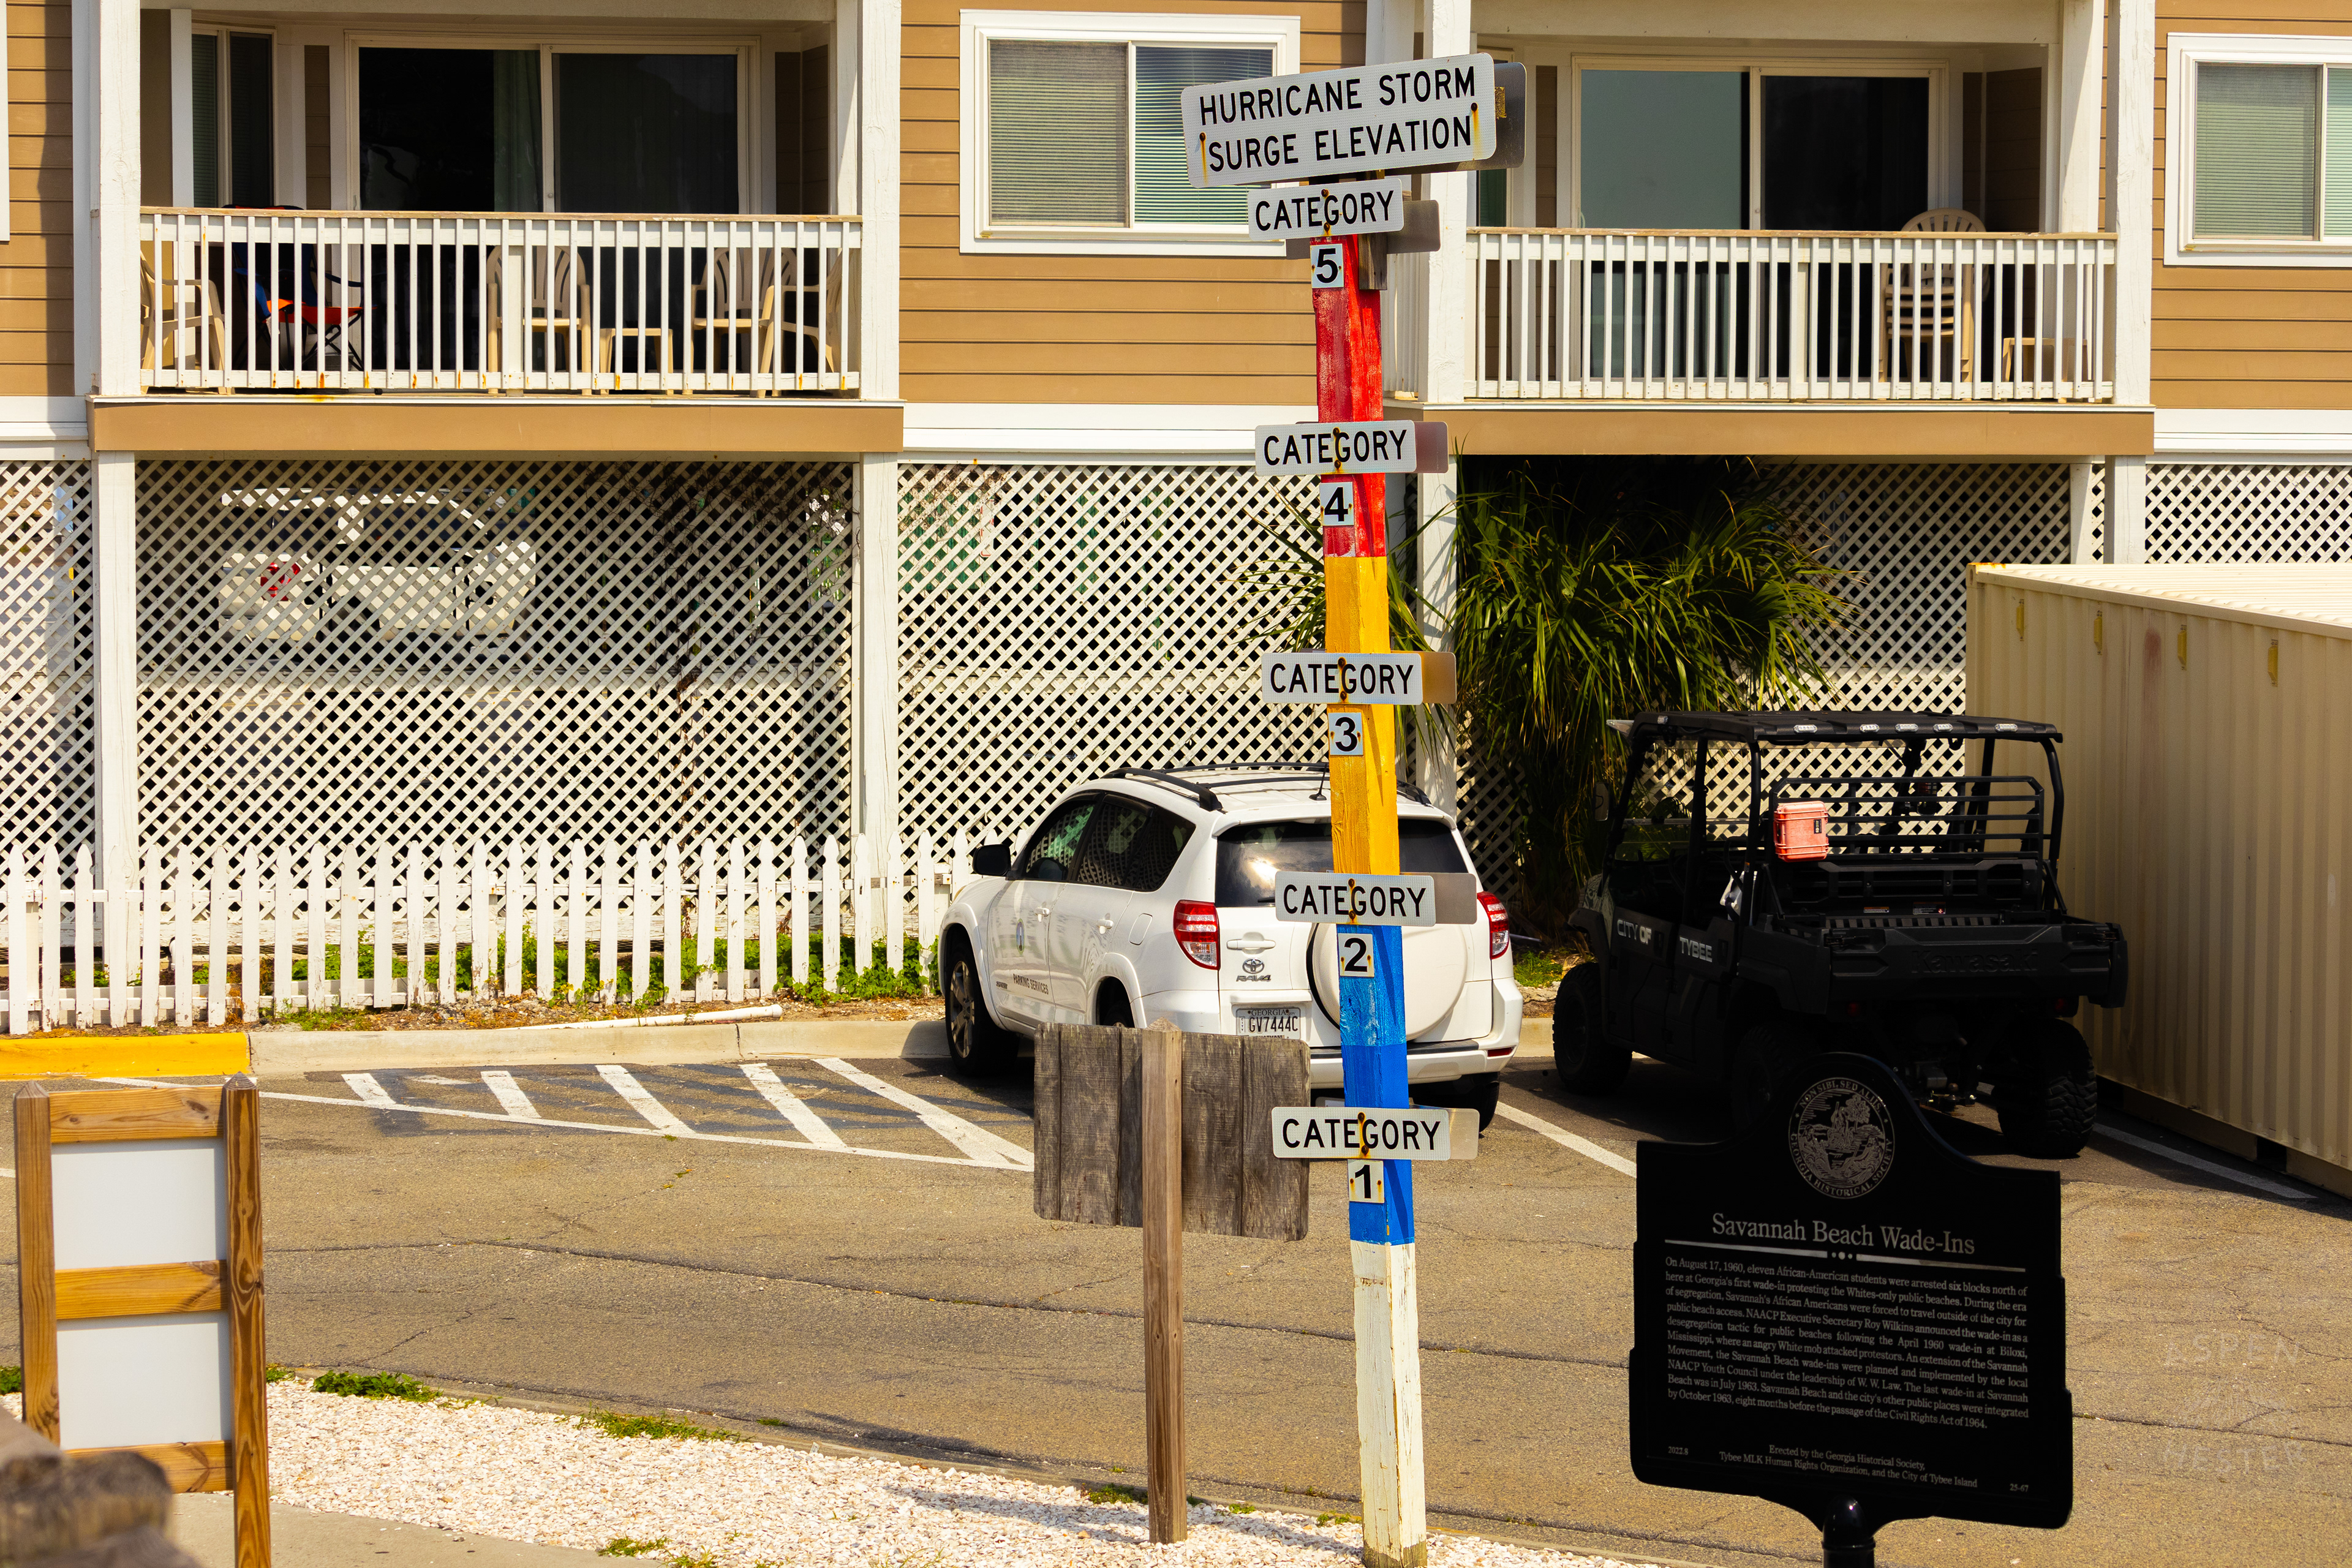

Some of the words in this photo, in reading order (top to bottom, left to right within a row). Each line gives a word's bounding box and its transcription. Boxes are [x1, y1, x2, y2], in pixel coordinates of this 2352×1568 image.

[1199, 78, 1363, 126] HURRICANE
[1379, 66, 1476, 107] STORM
[1208, 134, 1299, 173] SURGE
[1314, 115, 1471, 162] ELEVATION
[1256, 190, 1395, 231] CATEGORY
[1316, 247, 1339, 284] 5
[1264, 429, 1408, 466] CATEGORY
[1324, 487, 1349, 522] 4
[1270, 663, 1414, 695] CATEGORY
[1335, 717, 1359, 753] 3
[1283, 884, 1427, 918] CATEGORY
[1344, 938, 1368, 973] 2
[1616, 919, 1638, 940] CITY
[1639, 926, 1652, 945] OF
[1679, 937, 1713, 962] TYBEE
[1912, 949, 2038, 973] Kawasaki
[1013, 973, 1030, 988] PARKING
[1030, 979, 1049, 995] SERVICES
[1249, 1016, 1298, 1032] GV7444C
[1799, 1089, 1817, 1109] NON
[1840, 1080, 1858, 1091] SED
[1282, 1118, 1441, 1150] CATEGORY
[1354, 1164, 1372, 1199] 1
[1790, 1133, 1813, 1183] GEORGIA
[1814, 1179, 1873, 1197] HISTORICAL
[1873, 1139, 1893, 1183] SOCIETY
[1712, 1213, 1806, 1240] Savannah
[1812, 1220, 1874, 1246] Beach
[1880, 1226, 1974, 1254] Wade-Ins
[1665, 1256, 1677, 1267] On
[1679, 1257, 1707, 1270] August
[1709, 1261, 1721, 1272] 17,
[1724, 1262, 1745, 1273] 1960,
[1747, 1264, 1774, 1275] eleven
[1776, 1266, 1849, 1281] African-American
[1850, 1273, 1887, 1284] students
[1911, 1280, 1947, 1290] arrested
[1948, 1280, 1961, 1291] six
[1962, 1281, 1990, 1293] blocks
[1992, 1286, 2016, 1295] north
[2018, 1286, 2028, 1296] of
[1665, 1271, 1683, 1281] here
[1694, 1273, 1732, 1287] Georgia's
[1733, 1277, 1751, 1287] first
[1752, 1280, 1785, 1291] wade-in
[1787, 1284, 1830, 1296] protesting
[1831, 1286, 1844, 1295] the
[1846, 1287, 1897, 1302] Whites-only
[1898, 1292, 1924, 1303] public
[1925, 1294, 1962, 1306] beaches.
[1964, 1297, 1994, 1311] During
[1996, 1300, 2010, 1310] the
[1665, 1286, 1674, 1295] of
[1675, 1289, 1724, 1300] segregation,
[1725, 1291, 1770, 1304] Savannah's
[1772, 1295, 1801, 1306] African
[1803, 1298, 1848, 1311] Americans
[1849, 1304, 1871, 1313] were
[1872, 1303, 1899, 1315] forced
[1900, 1307, 1909, 1316] to
[1910, 1308, 1935, 1318] travel
[1937, 1311, 1968, 1321] outside
[1970, 1313, 1978, 1322] of
[1980, 1313, 1994, 1324] the
[1996, 1314, 2012, 1327] city
[2014, 1316, 2026, 1326] for
[1667, 1316, 1723, 1330] desegregation
[1727, 1322, 1749, 1332] tactic
[1754, 1324, 1766, 1333] for
[1770, 1325, 1795, 1336] public
[1798, 1327, 1832, 1340] beaches
[1836, 1331, 1875, 1345] following
[1879, 1335, 1893, 1345] the
[1898, 1336, 1918, 1348] April
[1923, 1339, 1943, 1349] 1960
[1948, 1343, 1982, 1354] wade-in
[1986, 1346, 1995, 1355] at
[2000, 1346, 2027, 1359] Biloxi,
[1668, 1345, 1713, 1359] Movement,
[1716, 1349, 1729, 1359] the
[1732, 1351, 1771, 1363] Savannah
[1773, 1354, 1799, 1366] Beach
[1801, 1359, 1839, 1370] wade-ins
[1841, 1363, 1862, 1372] were
[1865, 1363, 1898, 1375] planned
[1901, 1368, 1917, 1377] and
[1919, 1368, 1974, 1382] implemented
[1977, 1374, 1988, 1385] by
[1991, 1375, 2005, 1385] the
[2008, 1376, 2027, 1387] local
[1668, 1359, 1700, 1371] NAACP
[1701, 1362, 1725, 1373] Youth
[1727, 1365, 1758, 1377] Council
[1760, 1370, 1784, 1379] under
[1786, 1371, 1800, 1381] the
[1802, 1372, 1845, 1387] leadership
[1847, 1377, 1856, 1386] of
[1857, 1377, 1867, 1387] W.
[1869, 1378, 1879, 1389] W.
[1882, 1379, 1901, 1390] Law.
[1904, 1381, 1921, 1392] The
[1923, 1383, 1939, 1394] last
[1940, 1387, 1974, 1397] wade-in
[1987, 1389, 2028, 1403] Savannah
[1668, 1374, 1692, 1385] Beach
[1711, 1378, 1718, 1387] in
[1719, 1379, 1736, 1390] July
[1738, 1381, 1759, 1391] 1963.
[1760, 1382, 1800, 1395] Savannah
[1801, 1386, 1826, 1398] Beach
[1828, 1390, 1844, 1400] and
[1844, 1390, 1858, 1401] the
[1859, 1392, 1881, 1404] city's
[1882, 1395, 1905, 1405] other
[1907, 1397, 1932, 1408] public
[1934, 1400, 1960, 1411] places
[1961, 1404, 1983, 1413] were
[1984, 1404, 2029, 1417] integrated
[1719, 1451, 1741, 1462] Tybee
[1743, 1453, 1763, 1464] MLK
[1765, 1456, 1792, 1466] Human
[1794, 1459, 1818, 1470] Rights
[1871, 1468, 1885, 1477] and
[1887, 1469, 1900, 1478] the
[1902, 1470, 1918, 1482] City
[1920, 1473, 1928, 1482] of
[1929, 1473, 1952, 1484] Tybee
[1954, 1476, 1977, 1487] Island
[1769, 1444, 1798, 1456] Erected
[1800, 1448, 1809, 1458] by
[1811, 1449, 1823, 1458] the
[1825, 1450, 1855, 1463] Georgia
[1856, 1453, 1894, 1466] Historical
